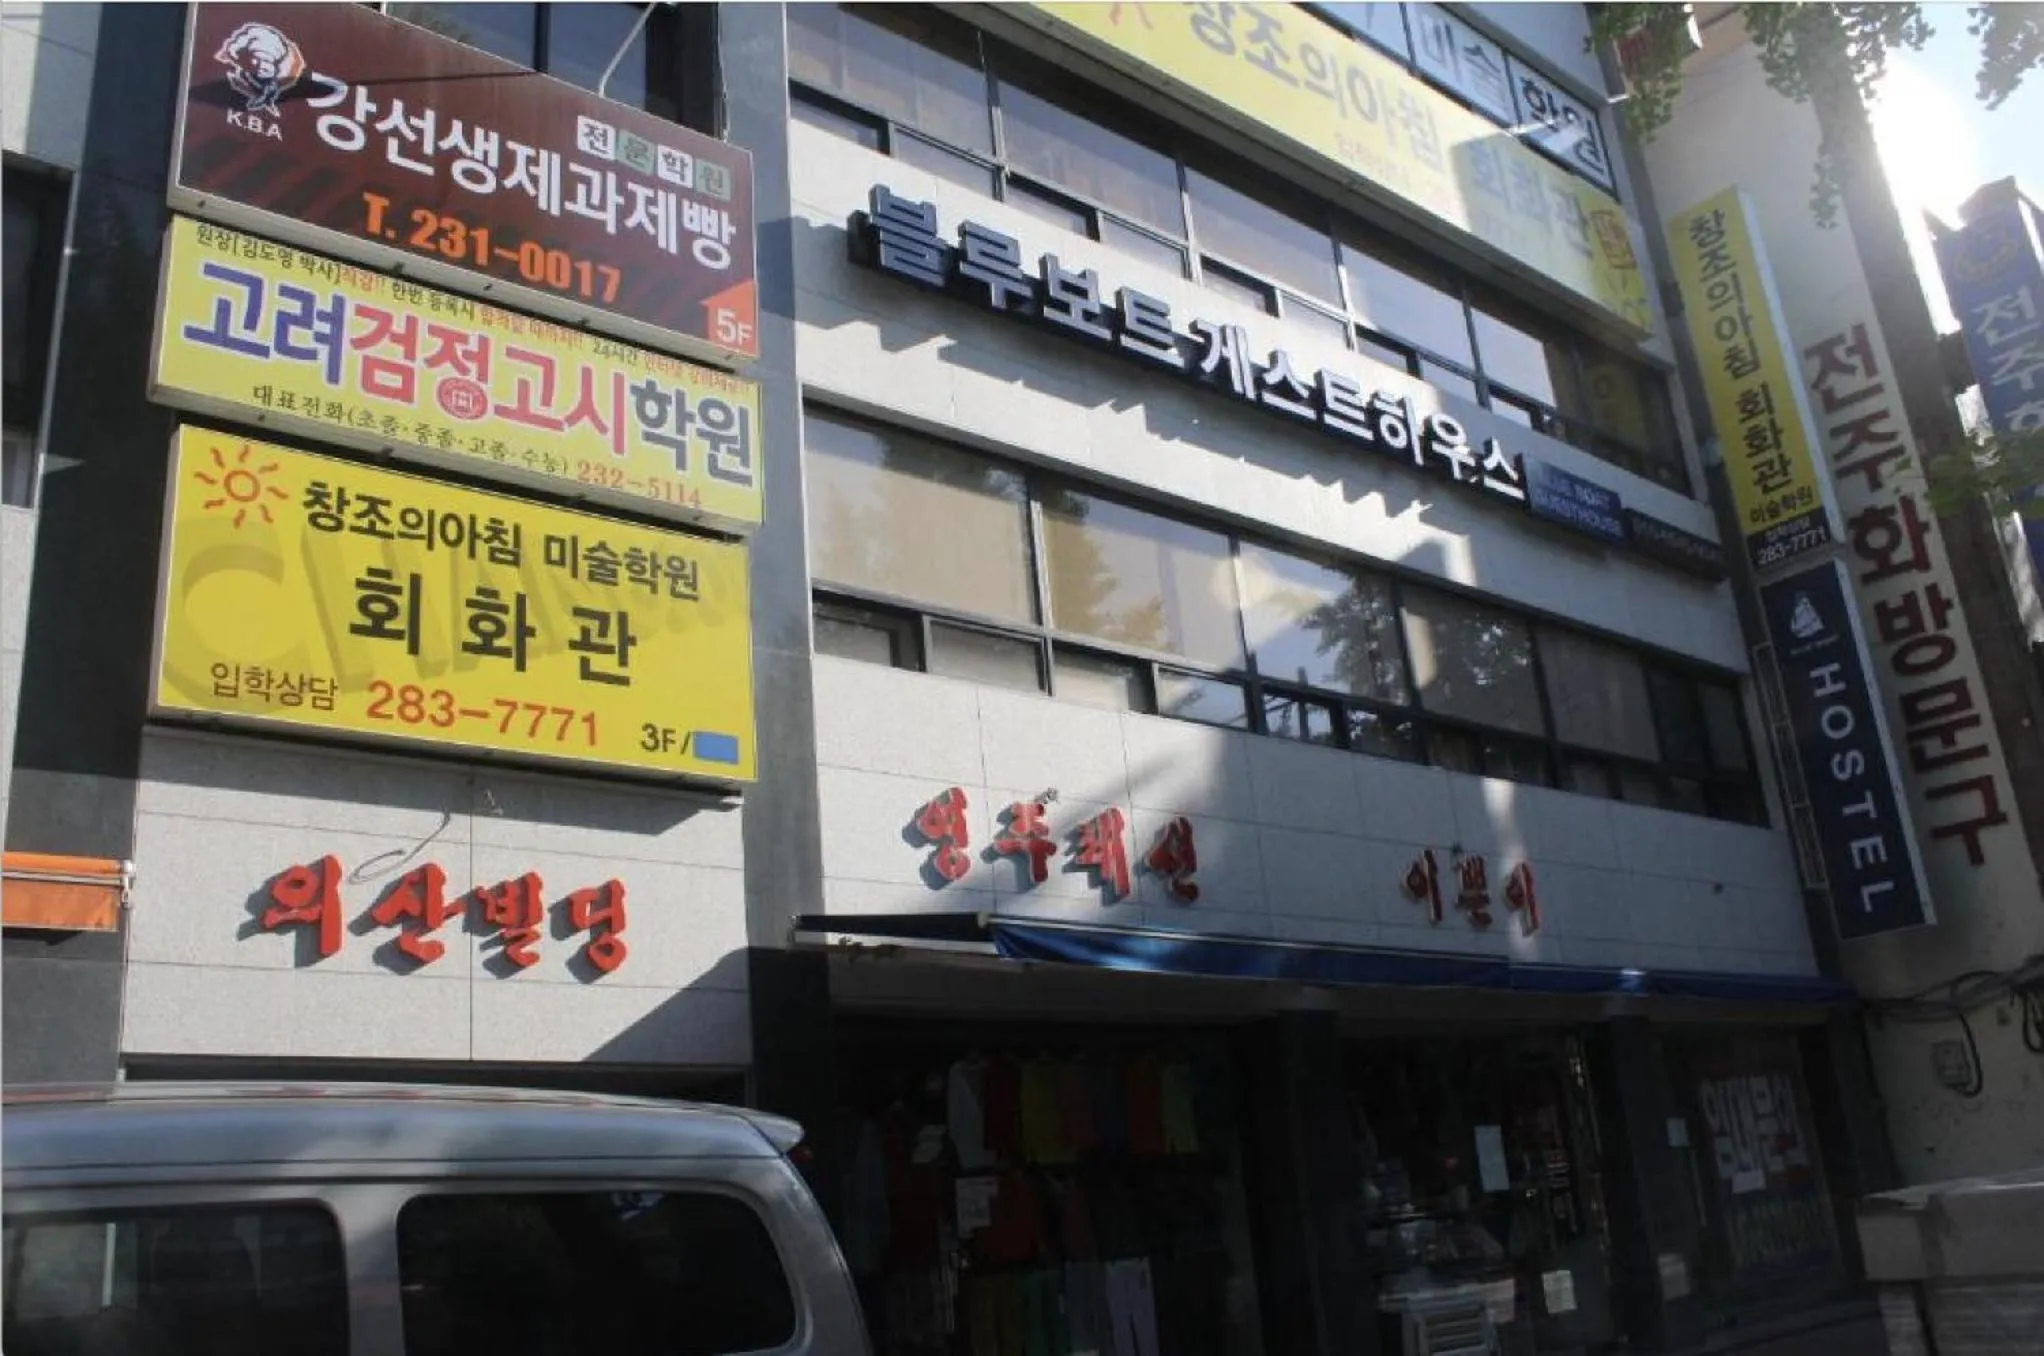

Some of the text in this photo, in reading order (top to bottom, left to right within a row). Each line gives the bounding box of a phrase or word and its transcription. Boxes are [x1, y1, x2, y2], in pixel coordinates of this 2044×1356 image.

[306, 72, 738, 270] 강선생제과제빵
[577, 114, 731, 202] 전문학원
[410, 207, 621, 303] 231-0017
[716, 307, 753, 347] 5F
[1689, 208, 1762, 382] 창조의아침
[1735, 383, 1793, 496] 회화관
[302, 480, 700, 602] 창조의아침 미술학원
[1803, 322, 2007, 867] 전주화방문구
[209, 661, 339, 712] 입학상담
[366, 680, 600, 748] 283-7771
[1809, 661, 1894, 913] HOSTEL
[258, 854, 629, 973] 의산빌딩
